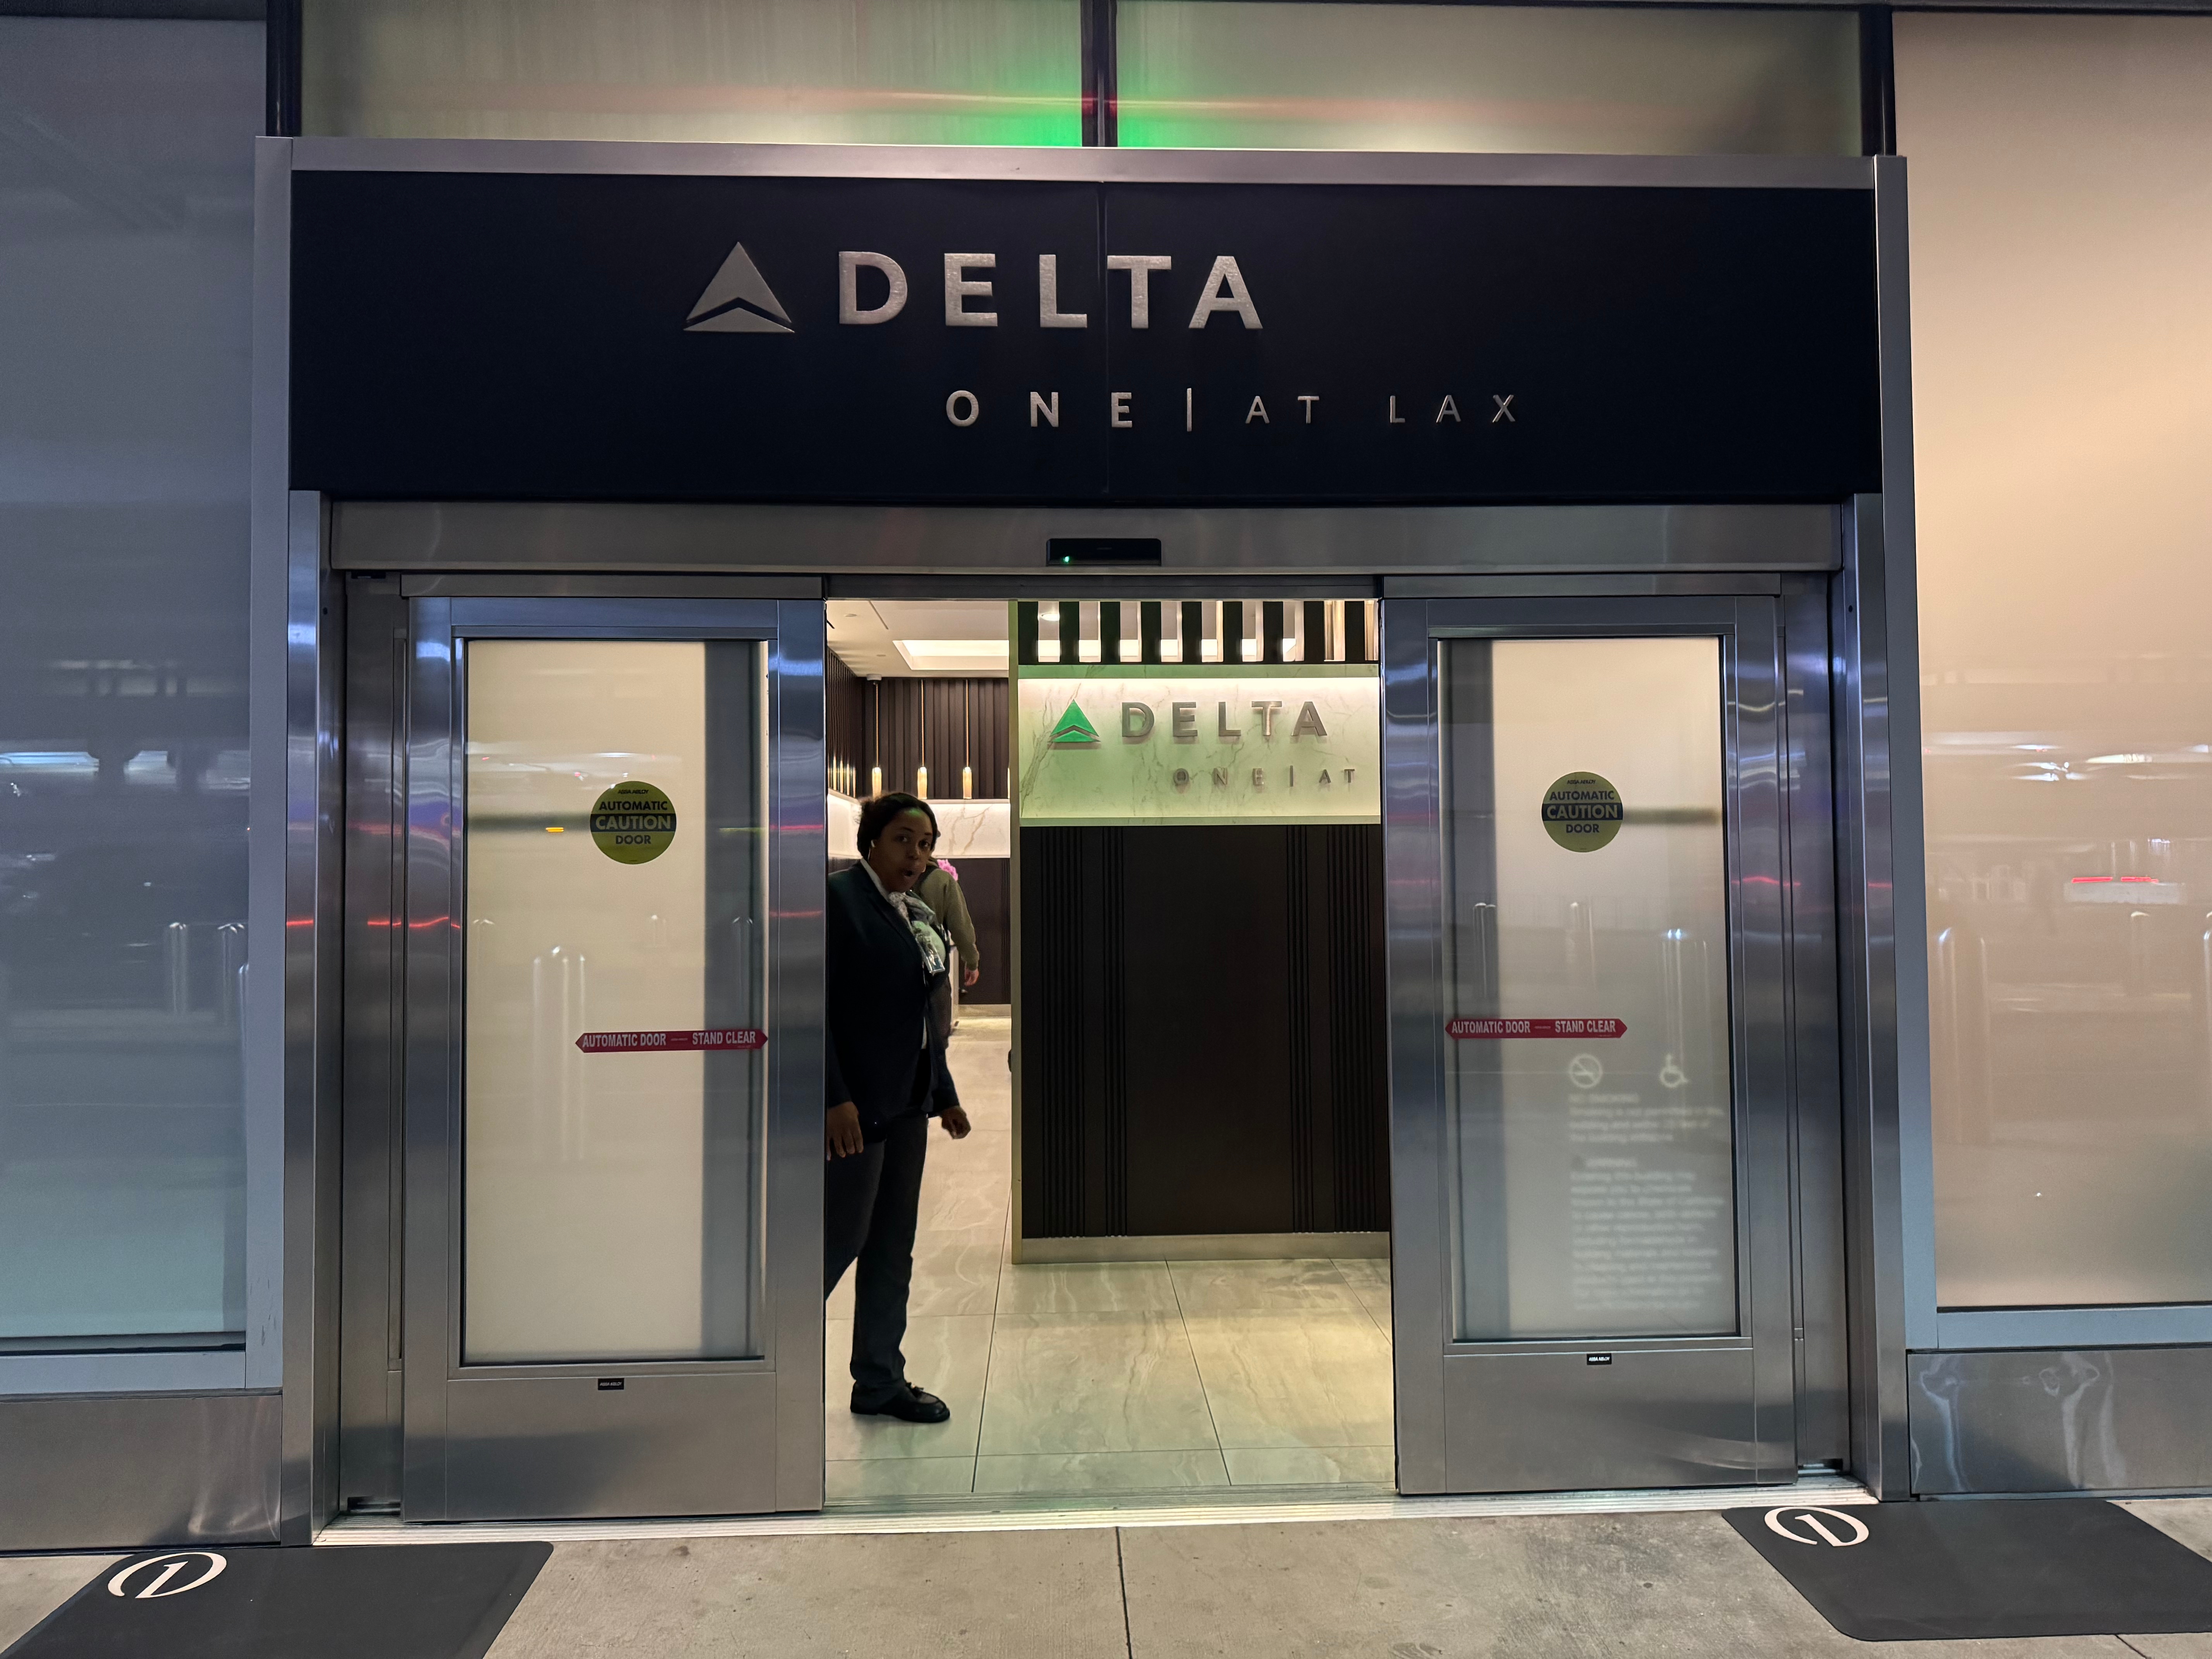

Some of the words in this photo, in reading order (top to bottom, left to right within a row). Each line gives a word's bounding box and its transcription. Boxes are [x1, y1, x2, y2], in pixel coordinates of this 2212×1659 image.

[838, 251, 1264, 330] DELTA
[945, 390, 1133, 428] ONE
[1245, 395, 1320, 424] AT
[1389, 394, 1516, 424] LAX
[1121, 701, 1328, 737] DELTA
[1173, 768, 1264, 786] ONE
[1319, 769, 1355, 783] AT
[1550, 790, 1614, 800] AUTOMATIC
[599, 801, 668, 810] AUTOMATIC
[1547, 804, 1617, 819] CAUTION
[596, 815, 670, 830] CAUTION
[1566, 824, 1599, 833] DOOR
[616, 835, 651, 844] DOOR
[1452, 1021, 1503, 1033] AUTOMATIC
[1506, 1021, 1530, 1032] DOOR
[1555, 1021, 1584, 1032] STAND
[1587, 1020, 1616, 1032] CLEAR
[582, 1034, 637, 1047] AUTOMATIC
[640, 1033, 666, 1046] DOOR
[692, 1032, 723, 1045] STAND
[726, 1031, 756, 1044] CLEAR
